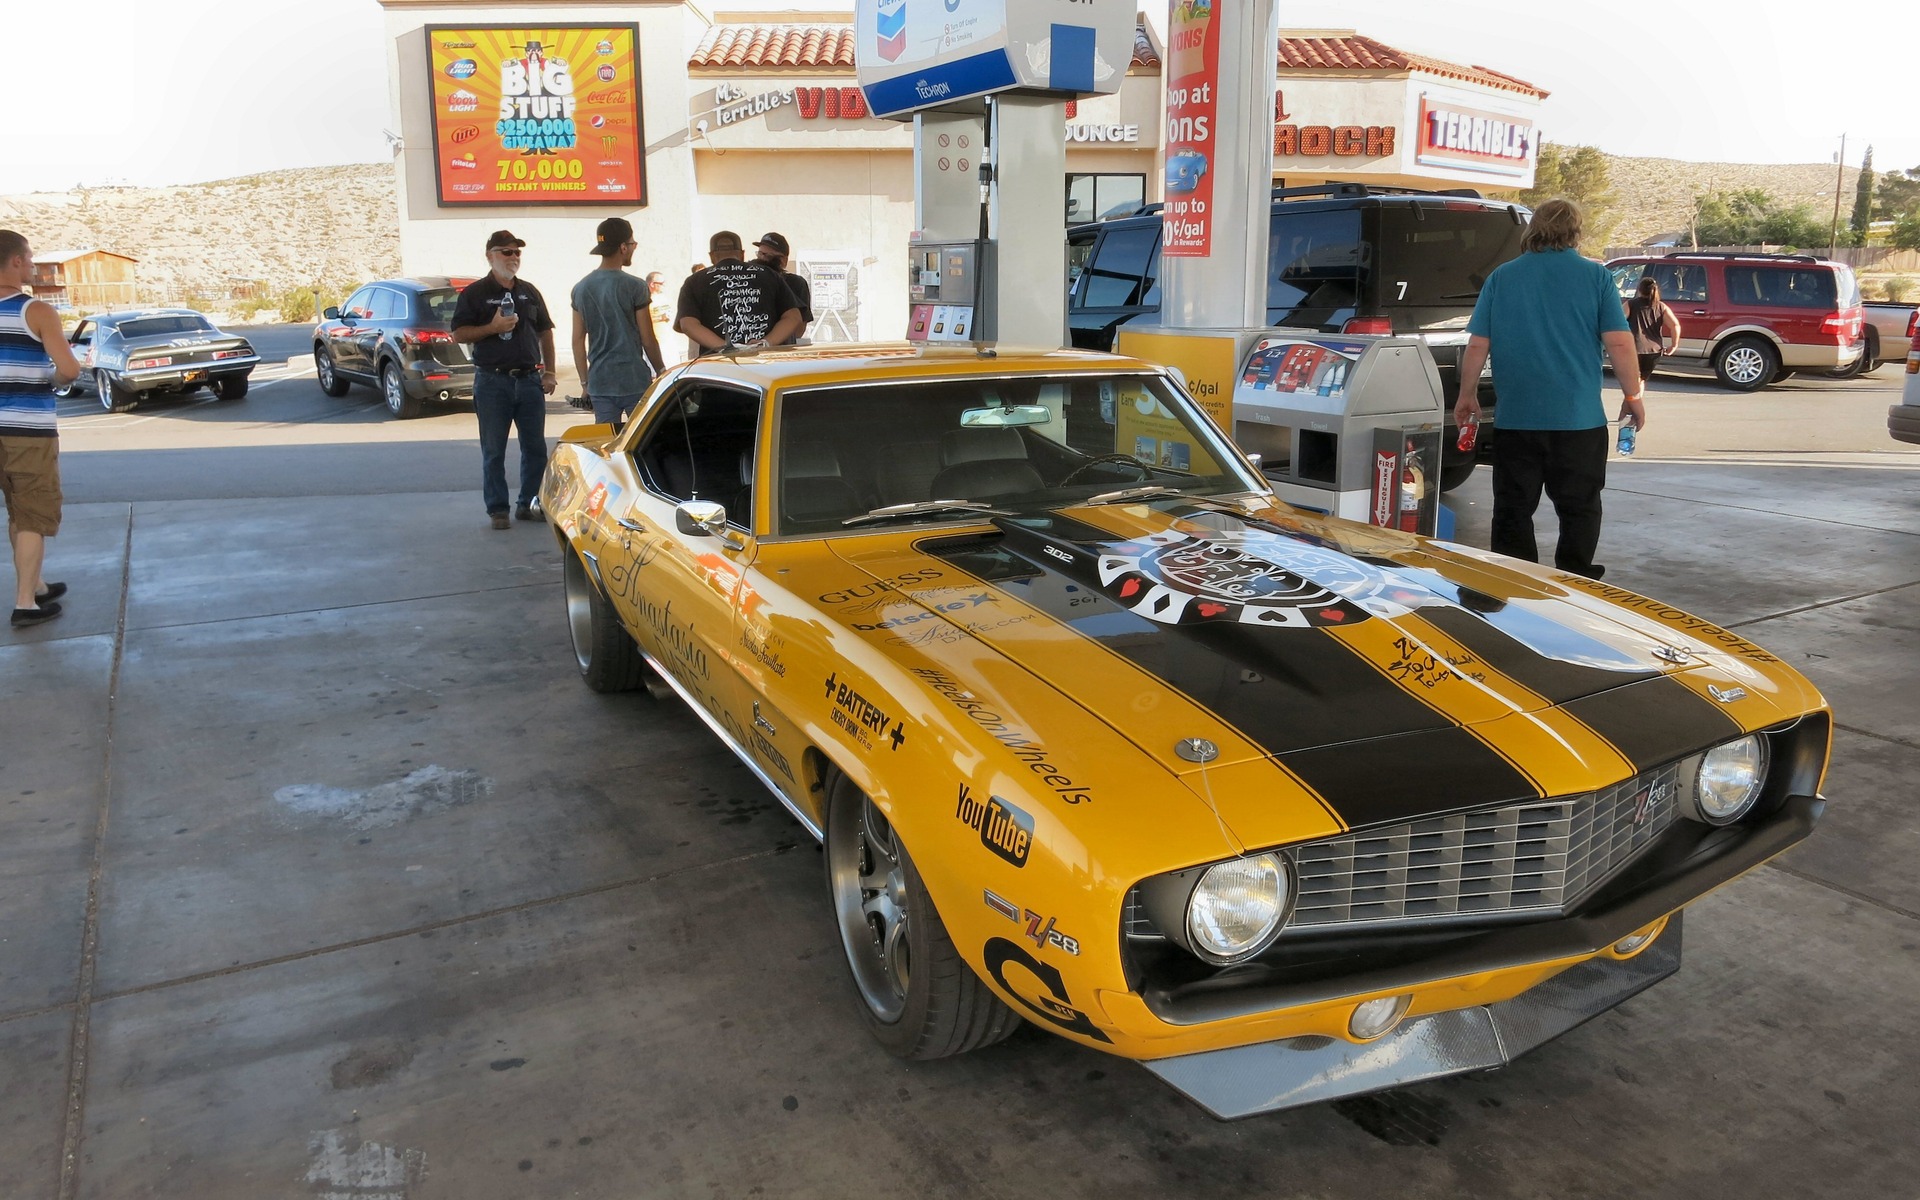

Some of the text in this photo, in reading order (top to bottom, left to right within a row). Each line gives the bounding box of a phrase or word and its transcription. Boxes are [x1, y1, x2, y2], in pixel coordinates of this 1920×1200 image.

[502, 59, 574, 96] BIG
[447, 93, 479, 106] Coors
[715, 82, 746, 104] Ms.
[916, 83, 951, 99] TECHRON
[1168, 82, 1210, 109] hop at
[499, 96, 577, 119] STUFF
[714, 86, 868, 126] Terrible's VID
[496, 118, 575, 136] $250,000
[1167, 112, 1209, 143] ons
[1434, 110, 1541, 160] TERRIBLE'S
[502, 135, 576, 149] GIVEAWAY
[497, 159, 583, 180] 70,000
[496, 182, 586, 191] INSTANT WINNERS
[1175, 201, 1188, 216] up
[1191, 197, 1205, 213] to
[1397, 281, 1408, 300] 7
[1255, 412, 1328, 430] Trash Towel
[1379, 460, 1394, 469] FIRE
[1380, 468, 1388, 524] EXTINGUISHER
[1043, 545, 1075, 564] 302
[819, 568, 943, 604] GUESS
[600, 537, 711, 681] Anastasia
[851, 601, 966, 631] betsafe
[1557, 573, 1779, 665] #HeelsOnWheels
[836, 682, 890, 736] BATTERY
[910, 667, 1092, 805] #HeelsOnWheels
[955, 782, 1028, 859] YouTube
